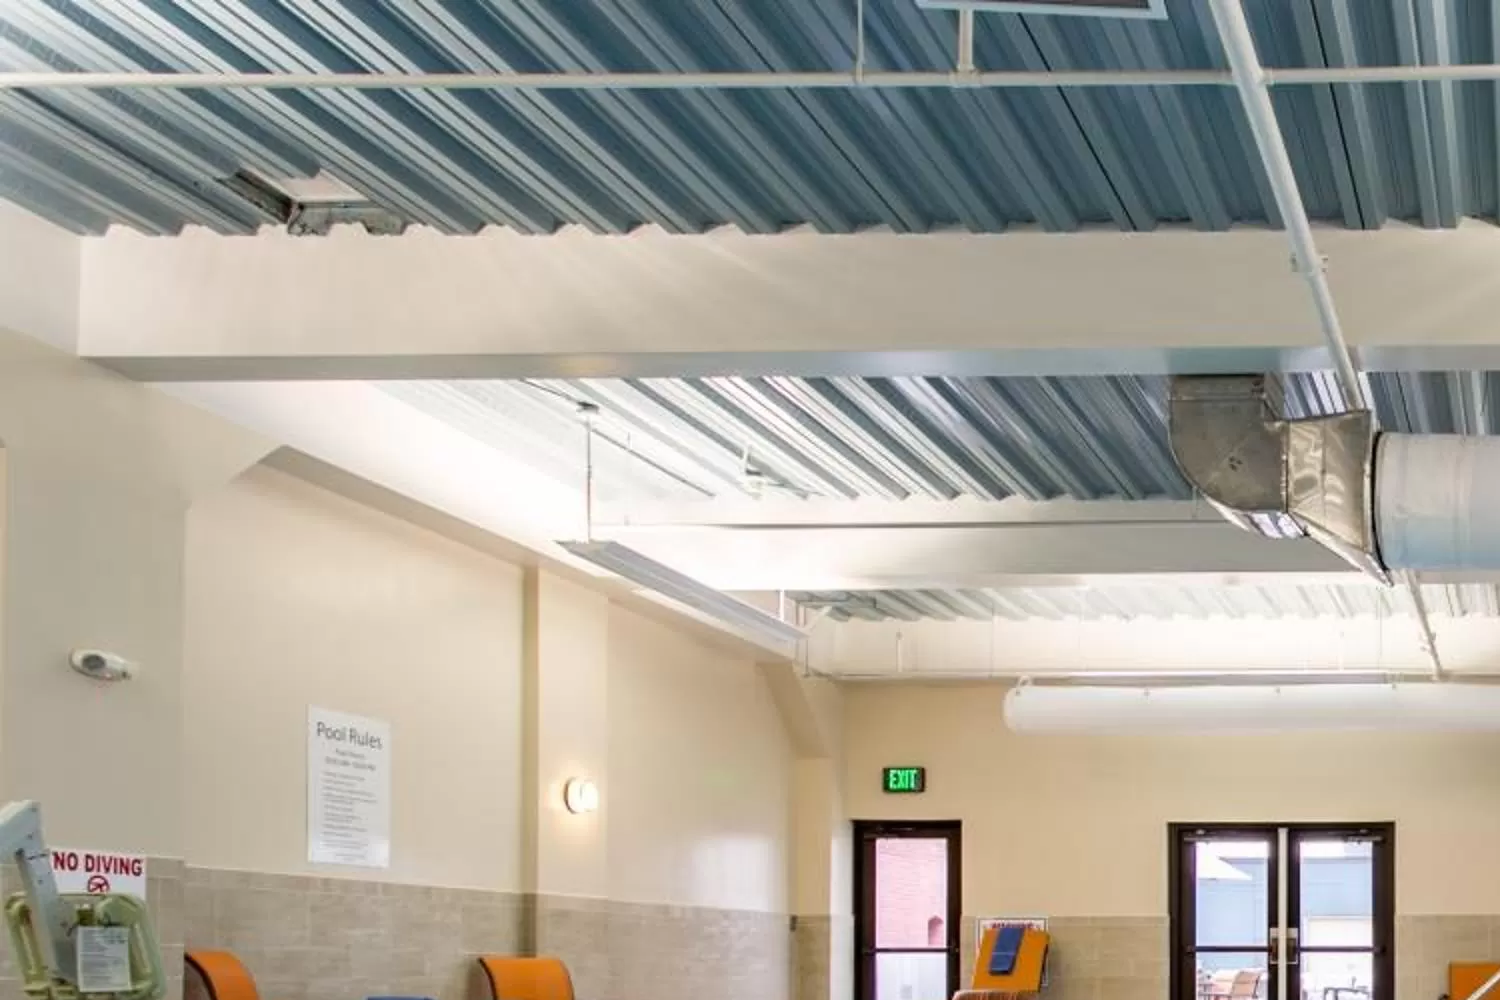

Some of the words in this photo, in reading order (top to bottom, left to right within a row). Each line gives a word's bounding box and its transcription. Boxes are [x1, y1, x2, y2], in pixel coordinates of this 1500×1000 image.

[316, 721, 346, 741] Pool
[349, 727, 383, 750] Rules
[889, 769, 917, 789] EXIT
[53, 851, 79, 871] NO
[84, 853, 143, 877] DIVING
